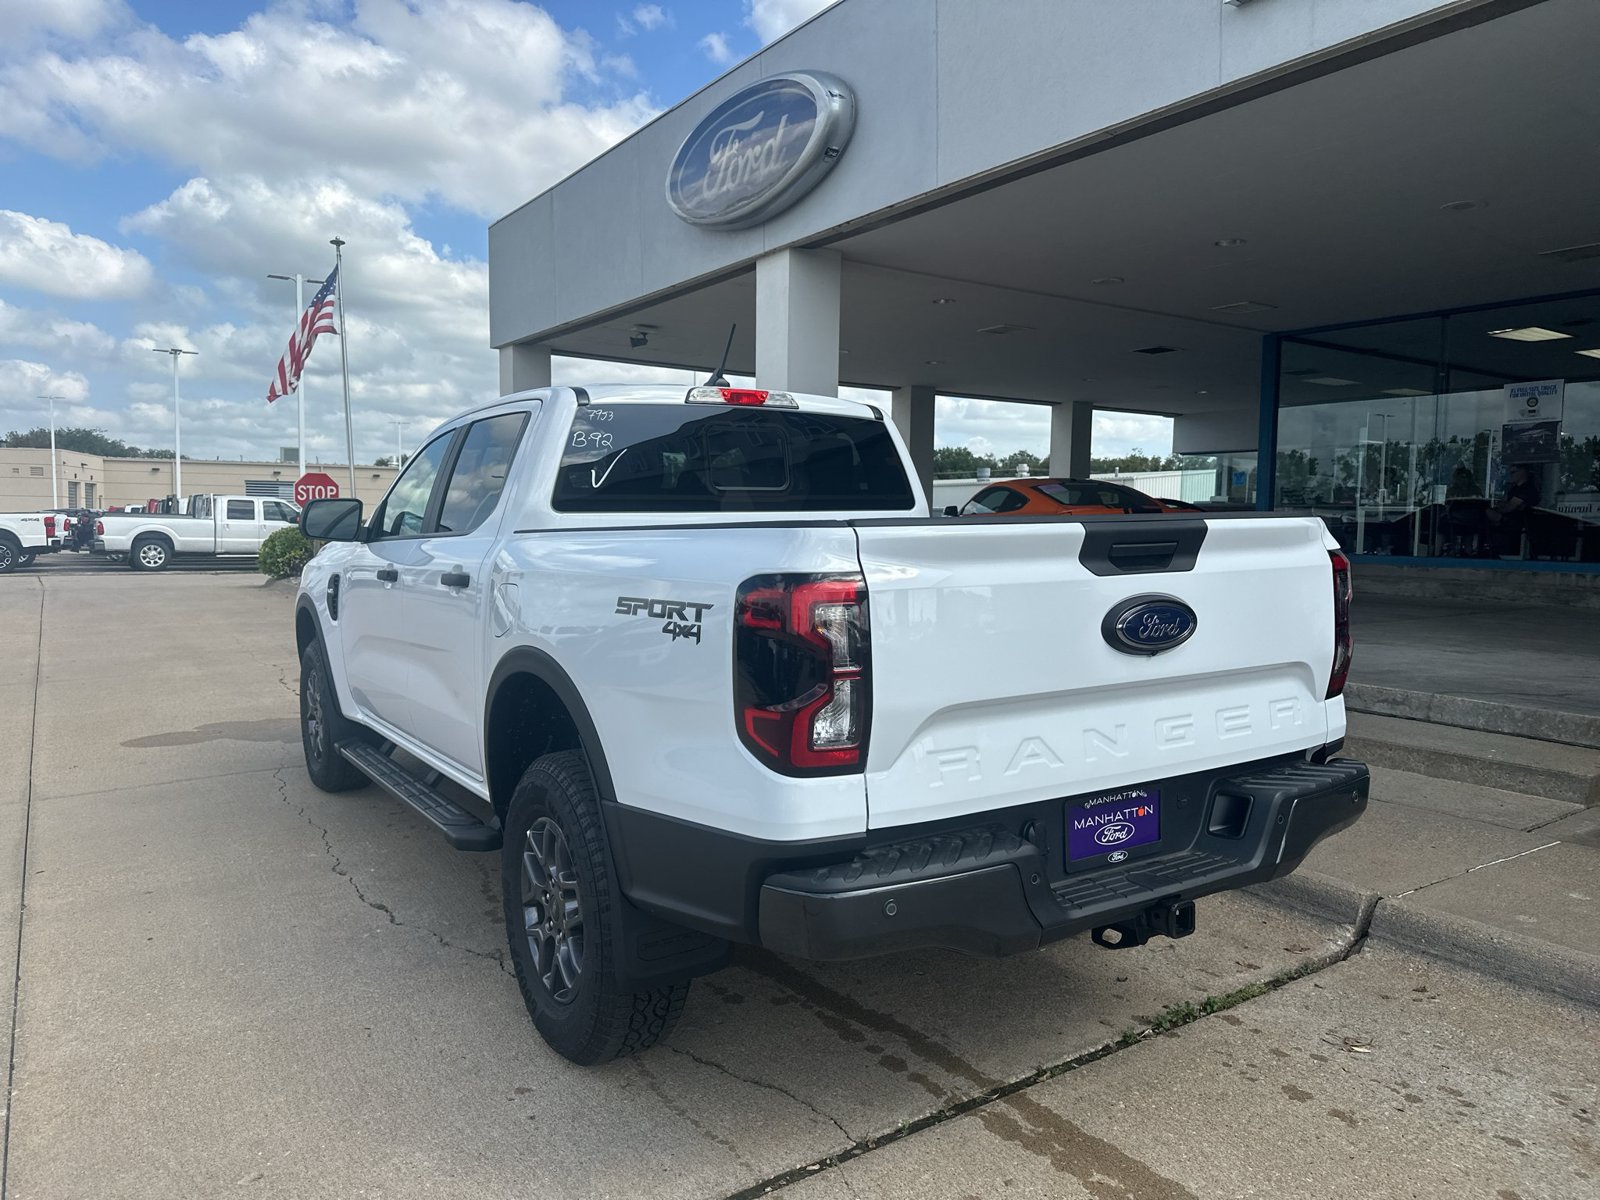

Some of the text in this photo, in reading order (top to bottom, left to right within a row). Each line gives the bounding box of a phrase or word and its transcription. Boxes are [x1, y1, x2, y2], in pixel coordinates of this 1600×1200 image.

[703, 110, 788, 198] Ford
[297, 485, 337, 501] STOP
[615, 597, 714, 623] SPORT
[1139, 613, 1180, 638] Ford
[926, 696, 1303, 788] RANGER
[1101, 825, 1128, 842] Ford
[1111, 852, 1125, 861] Ford
